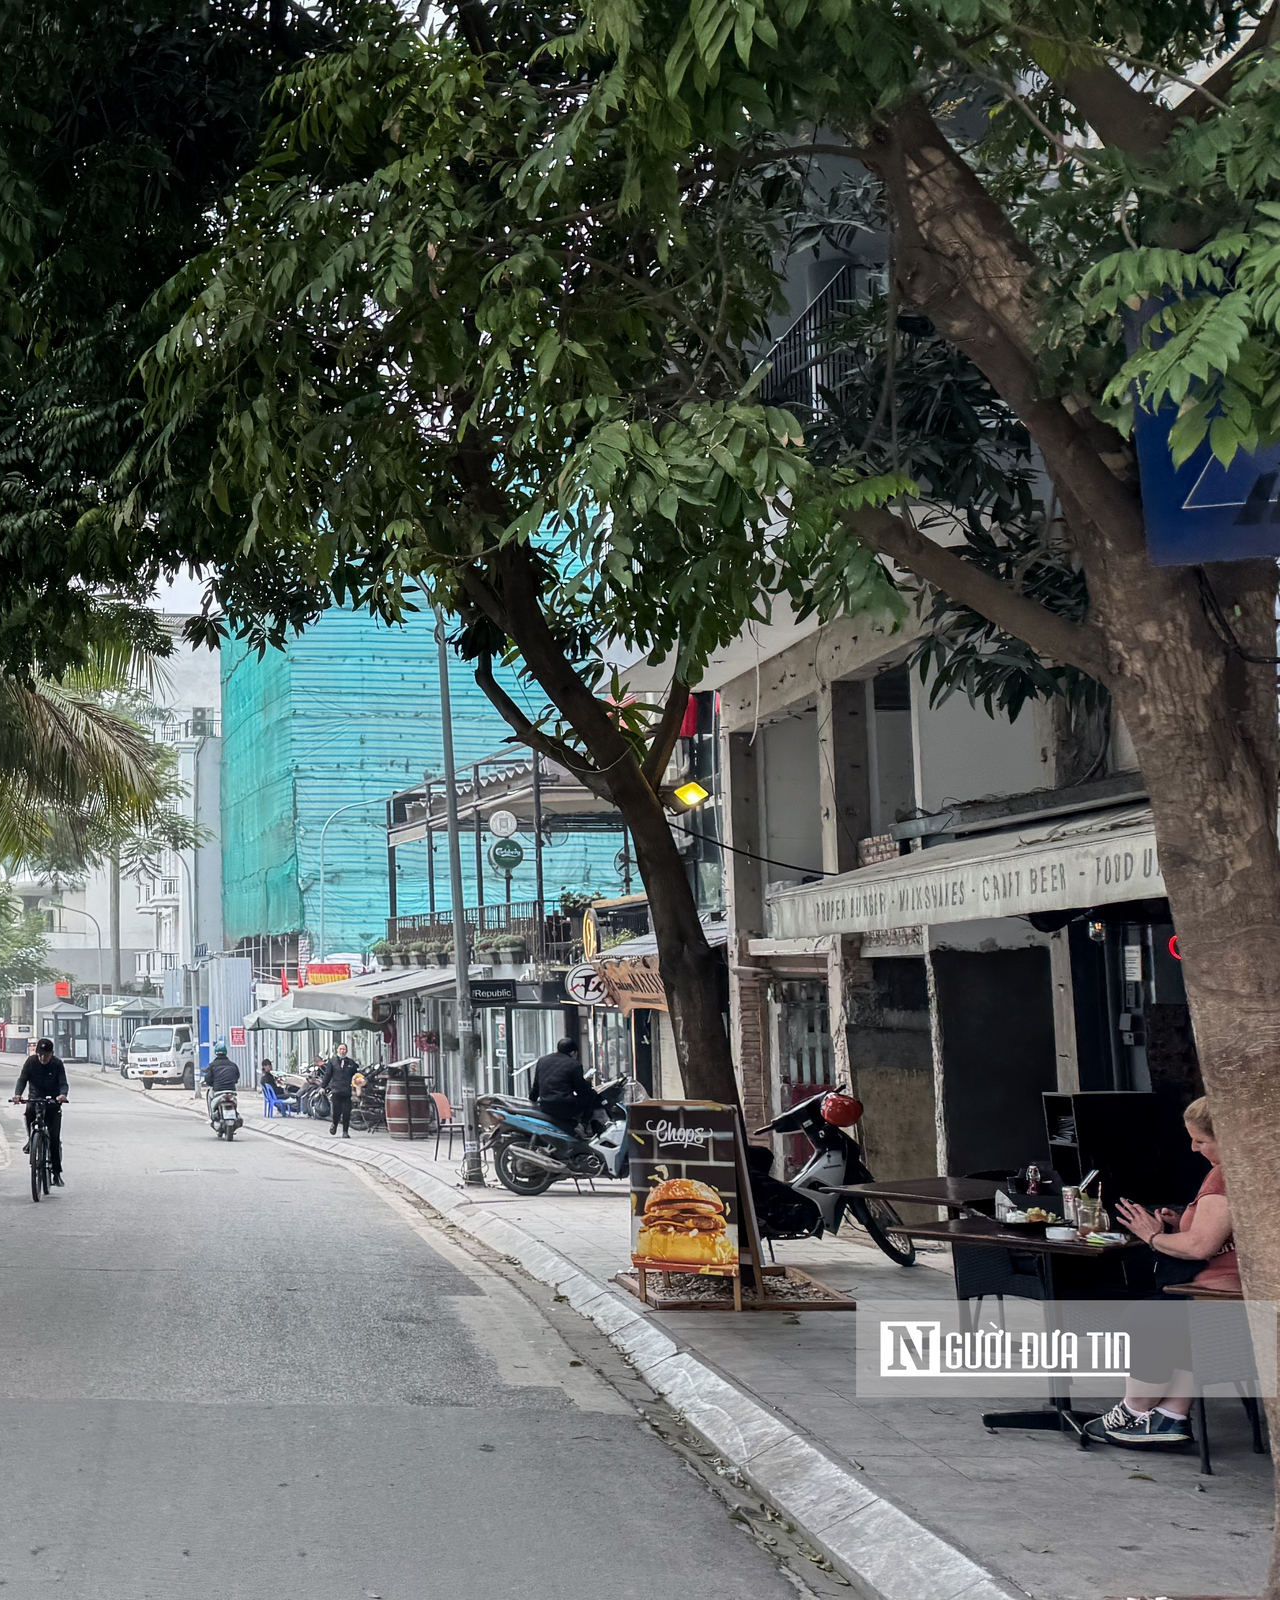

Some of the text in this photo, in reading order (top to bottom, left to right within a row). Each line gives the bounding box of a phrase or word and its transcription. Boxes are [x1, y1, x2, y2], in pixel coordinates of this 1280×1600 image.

[815, 899, 847, 923] PROPER
[850, 892, 886, 918] BURGER
[982, 870, 1020, 902] CRAFT
[1030, 862, 1066, 895] BEER
[1095, 852, 1134, 886] FOOD
[646, 1119, 713, 1149] Chops
